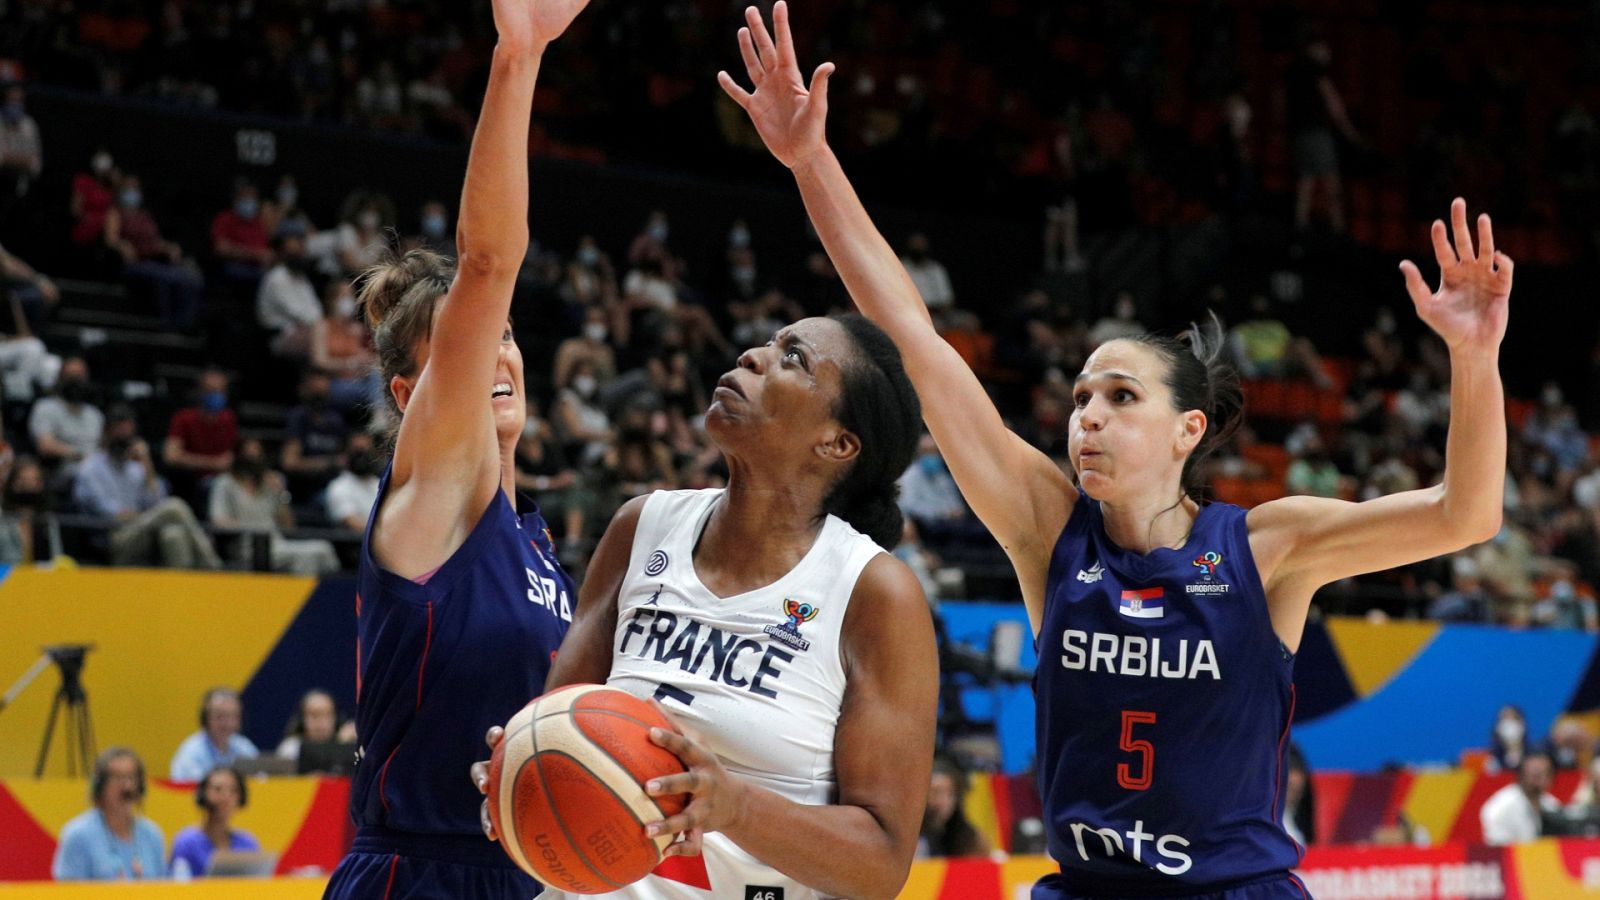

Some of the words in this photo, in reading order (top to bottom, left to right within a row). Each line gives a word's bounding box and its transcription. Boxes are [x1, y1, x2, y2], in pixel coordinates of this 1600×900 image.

[1185, 584, 1230, 593] EUROBASKET
[619, 607, 795, 700] FRANCE
[764, 625, 810, 651] EUROBASKET
[1061, 629, 1222, 680] SRBIJA
[1116, 710, 1157, 791] 5
[1069, 819, 1193, 876] mts
